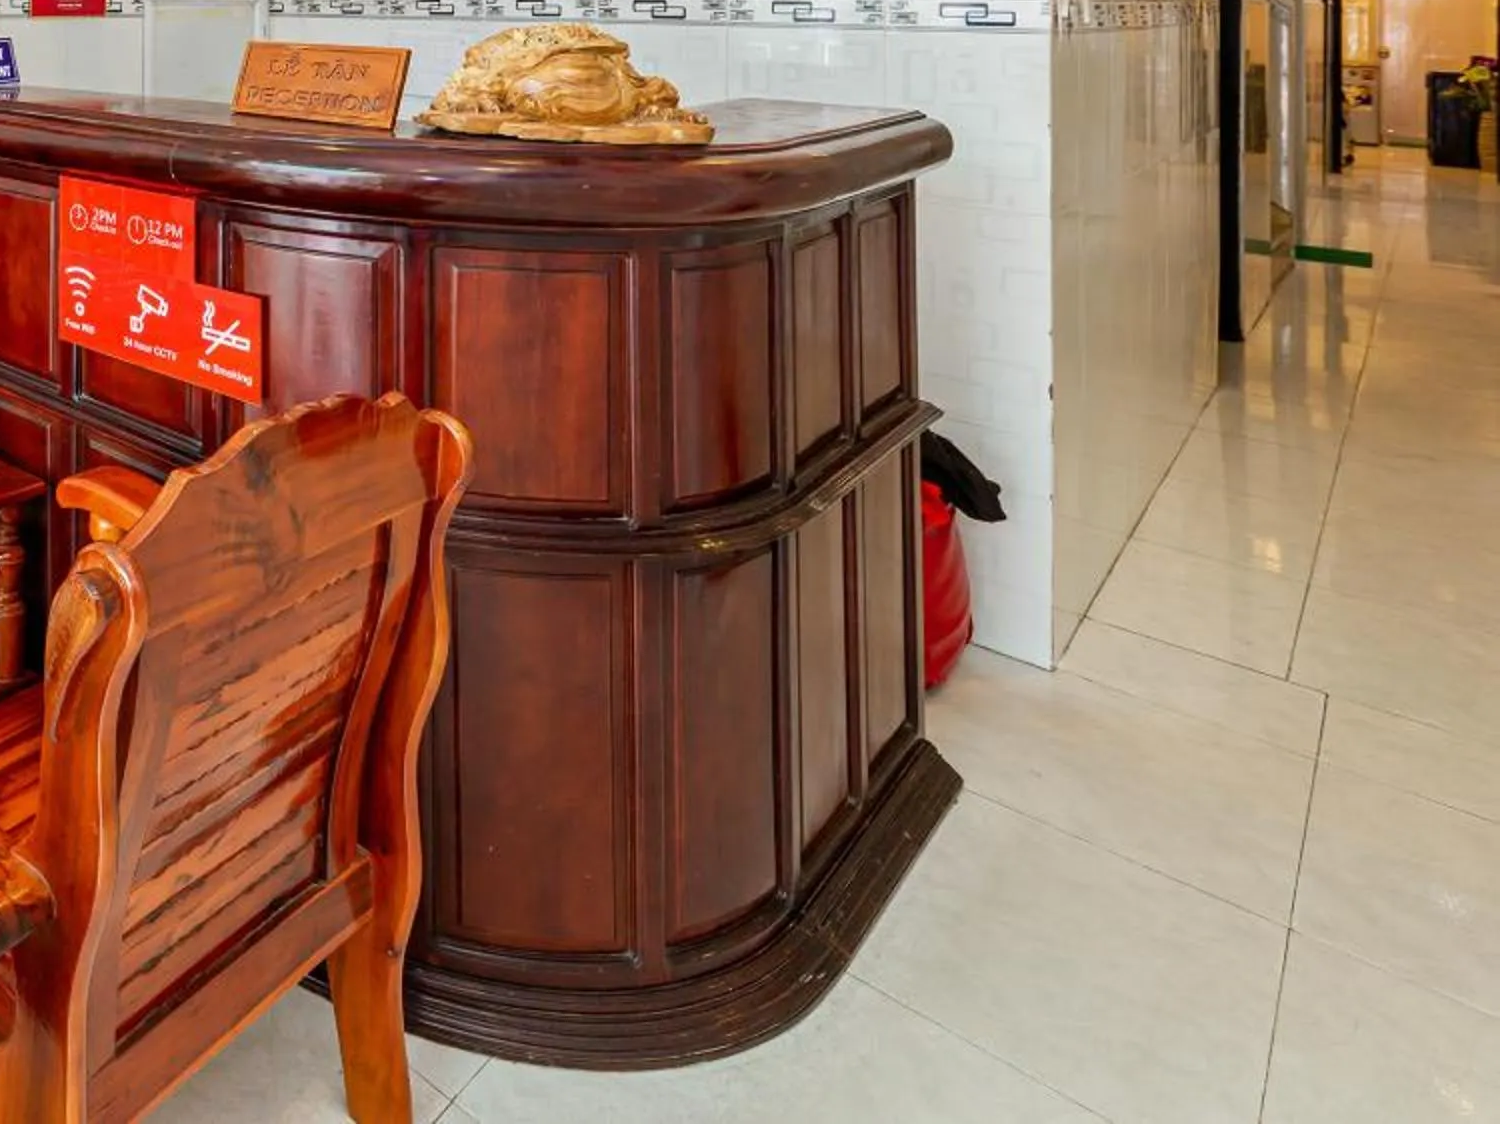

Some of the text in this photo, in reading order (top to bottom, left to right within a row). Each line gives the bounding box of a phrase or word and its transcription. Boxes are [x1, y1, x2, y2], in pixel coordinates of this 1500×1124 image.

[148, 219, 183, 239] 12 PM
[153, 345, 178, 362] CCTV
[198, 359, 253, 387] No Smoking
